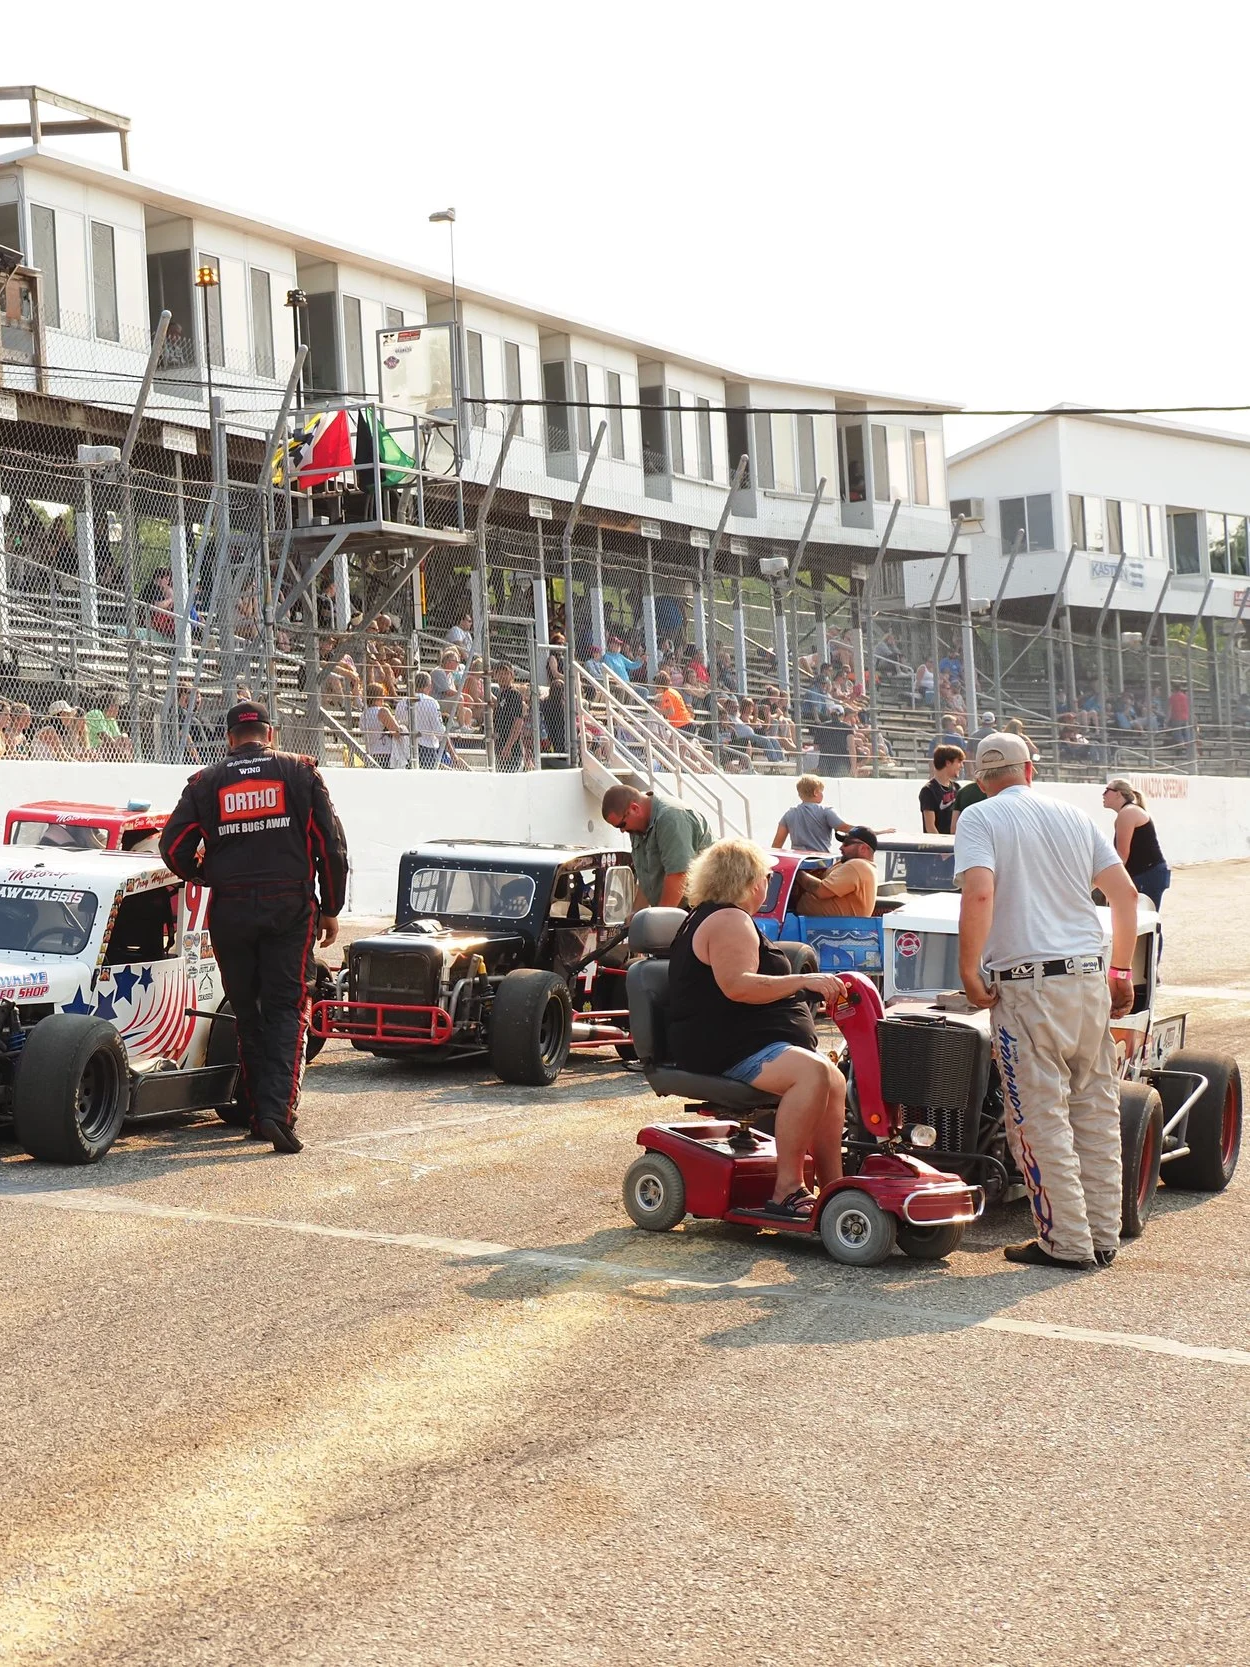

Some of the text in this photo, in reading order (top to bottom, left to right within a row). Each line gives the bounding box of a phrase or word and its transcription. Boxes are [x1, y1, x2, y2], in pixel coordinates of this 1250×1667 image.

[238, 766, 261, 775] WING
[224, 787, 278, 814] ORTHO
[242, 820, 265, 834] BUGS
[266, 816, 291, 830] AWAY
[21, 888, 85, 905] CHASSIS
[17, 985, 51, 1000] SHOP
